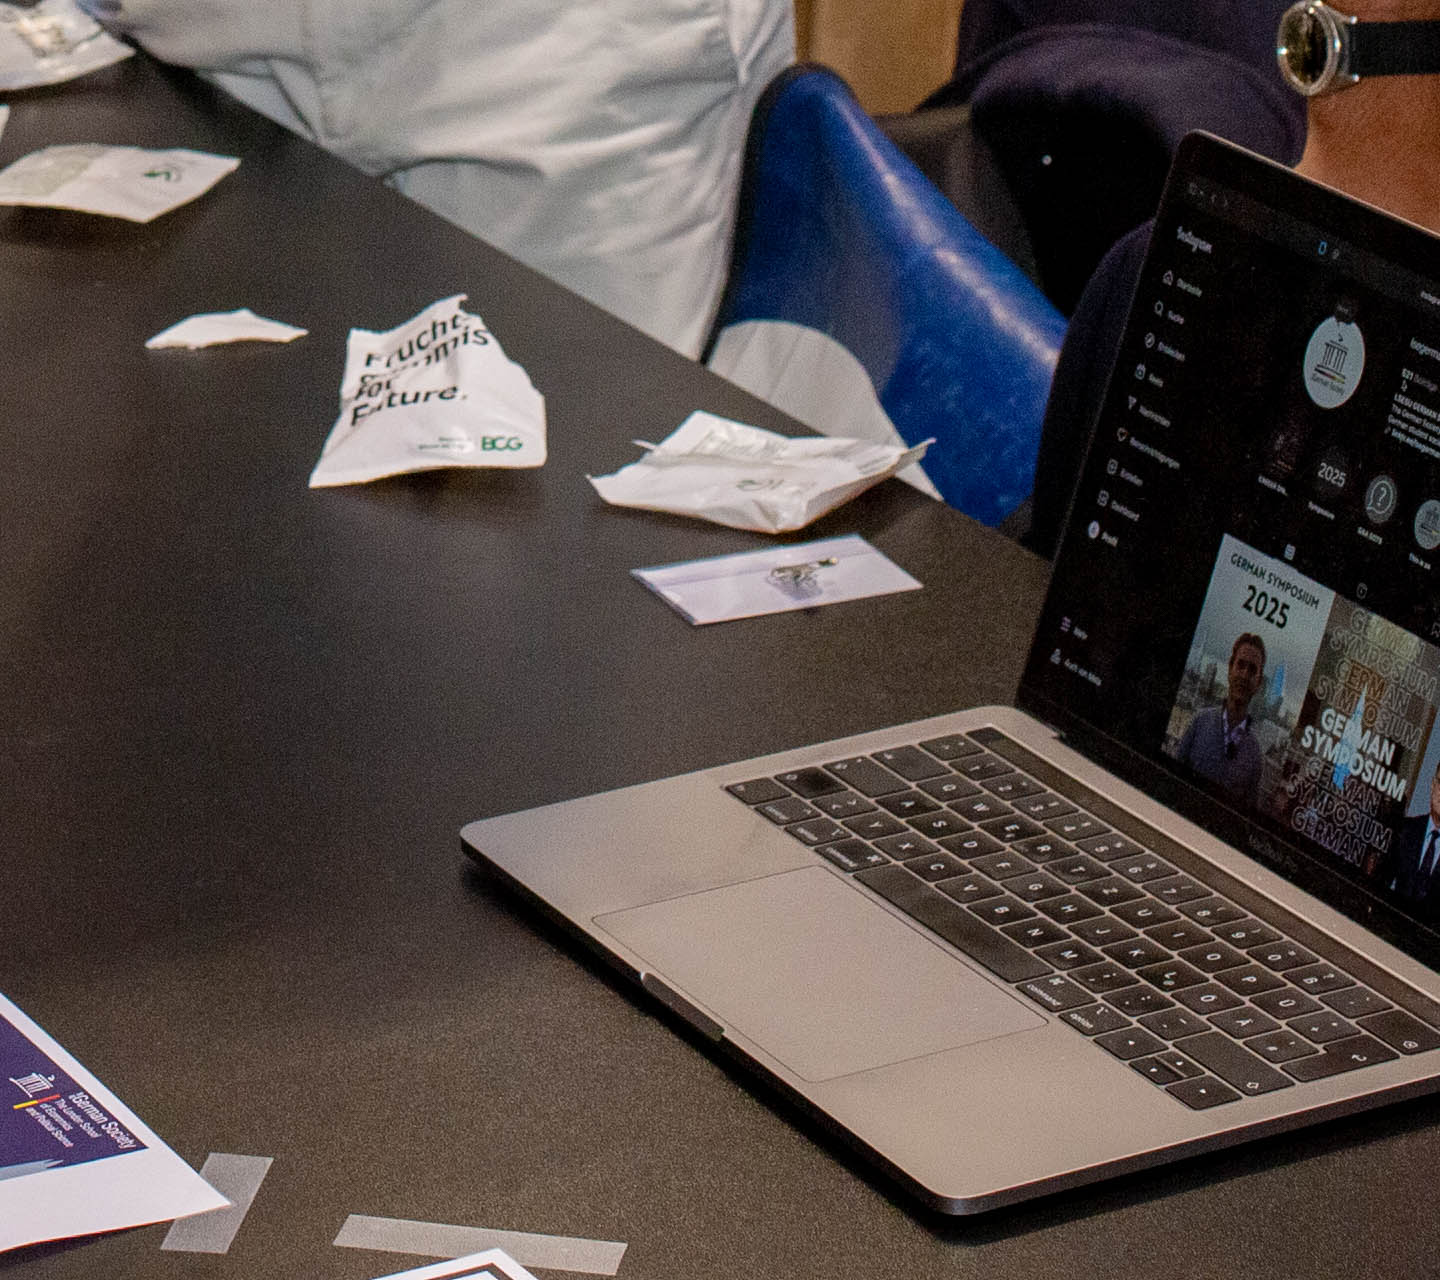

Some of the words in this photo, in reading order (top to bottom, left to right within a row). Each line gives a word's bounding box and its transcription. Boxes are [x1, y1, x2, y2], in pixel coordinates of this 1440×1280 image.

[1413, 402, 1437, 419] GERMAN
[480, 436, 524, 453] BCG
[1318, 462, 1346, 487] 2025
[1230, 553, 1266, 579] GERMAN
[1266, 572, 1320, 609] SYMPOSIUM
[1242, 585, 1290, 629] 2025
[1318, 704, 1397, 768] GERMAN
[1298, 722, 1408, 803] SYMPOSIUM
[68, 1094, 108, 1124] German
[101, 1121, 136, 1149] Society
